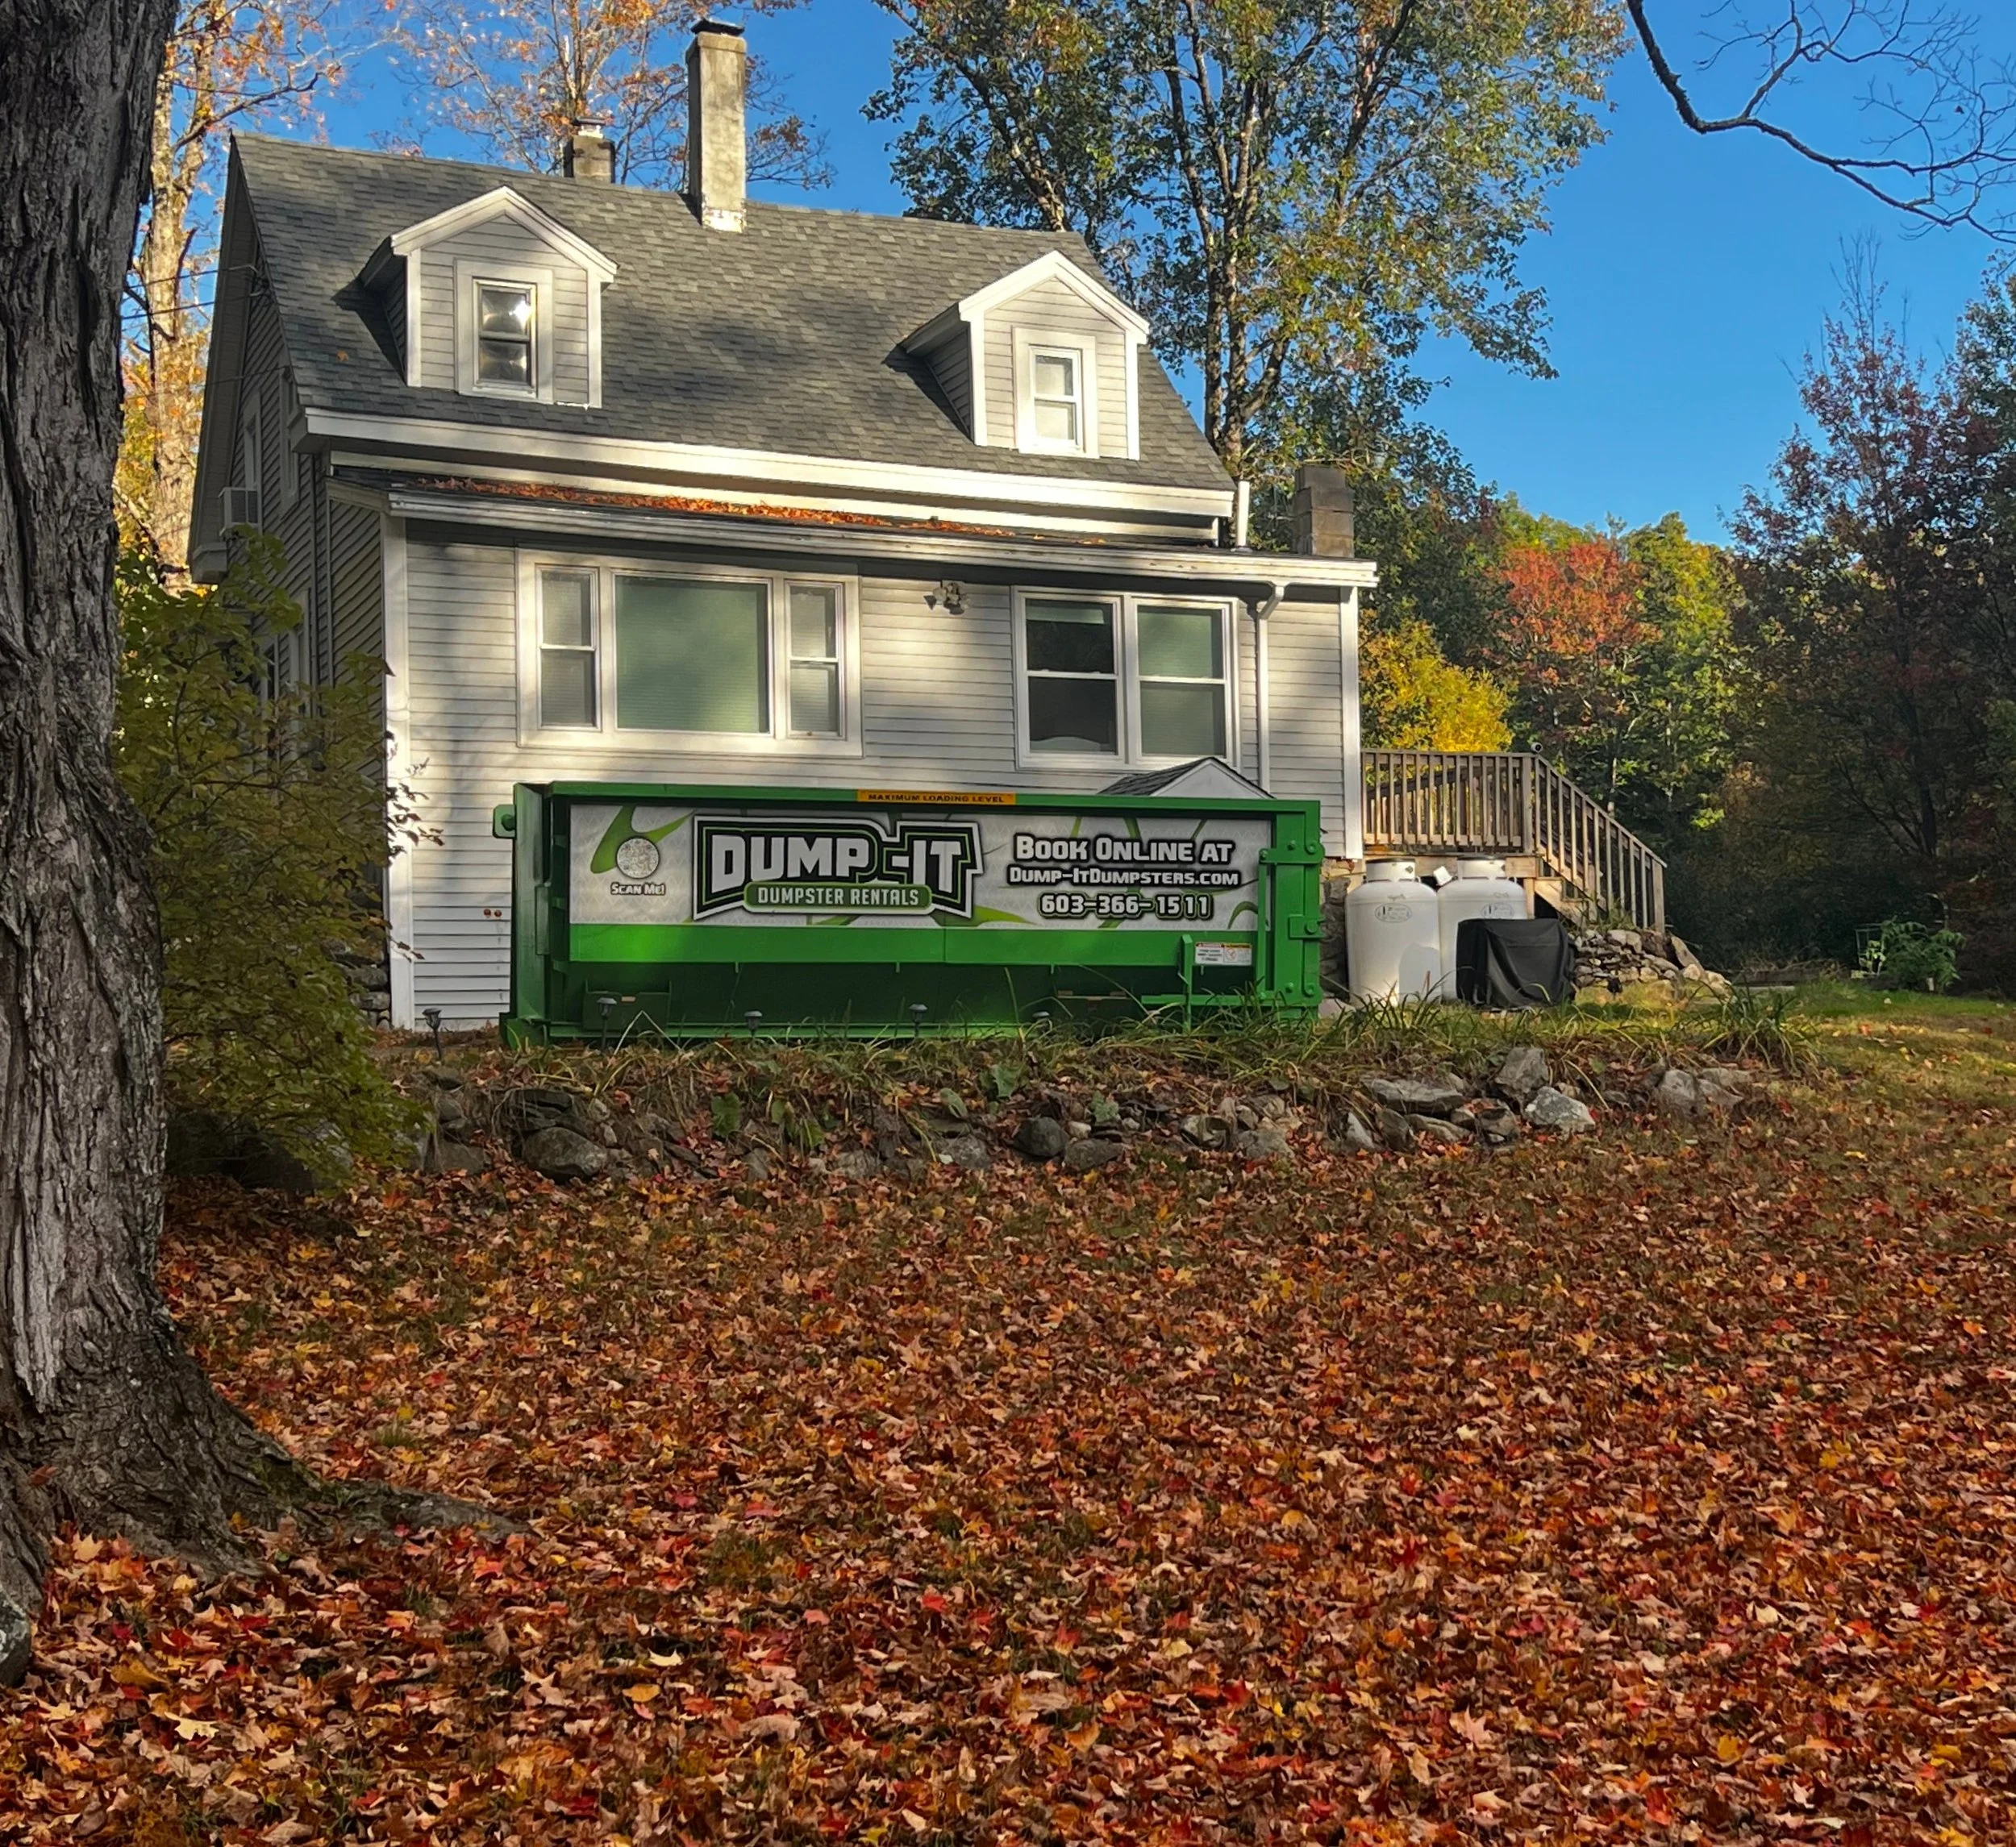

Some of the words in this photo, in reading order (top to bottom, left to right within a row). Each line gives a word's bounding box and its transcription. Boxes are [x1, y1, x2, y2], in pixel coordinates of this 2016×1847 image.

[868, 793, 920, 801] MAXIMUM
[923, 794, 969, 802] LOADING
[973, 795, 1004, 803] LEVEL
[1015, 834, 1089, 861] BOOK
[1095, 837, 1193, 862] ONLINE
[711, 834, 961, 893] DUMP-IT
[611, 882, 642, 894] SCAN
[757, 886, 844, 905] DUMPSTER
[851, 888, 919, 906] RENTALS
[1040, 893, 1209, 915] 603-366-1511
